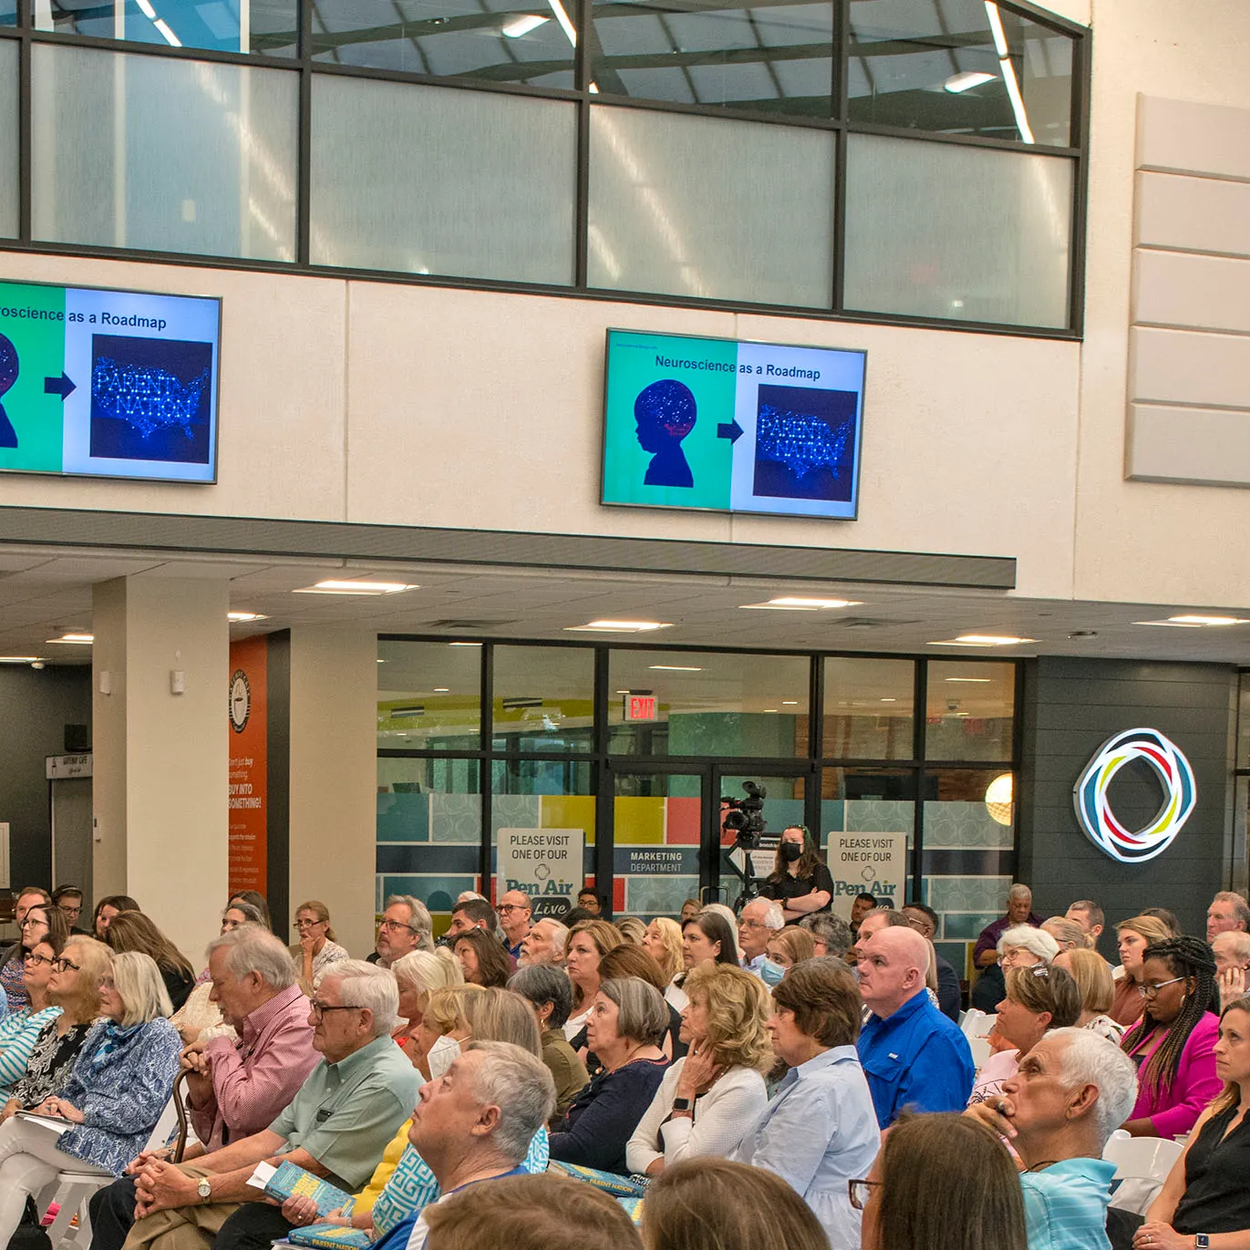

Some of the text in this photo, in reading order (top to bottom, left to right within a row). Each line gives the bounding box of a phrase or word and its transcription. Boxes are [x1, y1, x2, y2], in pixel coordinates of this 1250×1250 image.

[68, 310, 84, 323] as
[89, 312, 97, 324] a
[101, 312, 167, 330] Roadmap
[655, 355, 821, 381] Neuroscience as a Roadmap
[97, 371, 176, 396] PARENT
[116, 395, 192, 418] NATION
[760, 419, 829, 440] PARENT
[776, 440, 840, 461] NATION
[630, 697, 655, 719] EXIT
[510, 835, 570, 846] PLEASE VISIT
[839, 838, 894, 849] PLEASE VISIT
[511, 849, 568, 860] ONE OF OUR
[630, 852, 683, 861] MARKETING
[841, 852, 892, 862] ONE OF OUR
[630, 863, 682, 872] DEPARTMENT
[506, 878, 574, 895] Pen Air
[835, 880, 897, 896] Pen Air
[533, 901, 568, 915] Live
[311, 1238, 336, 1249] PARENT
